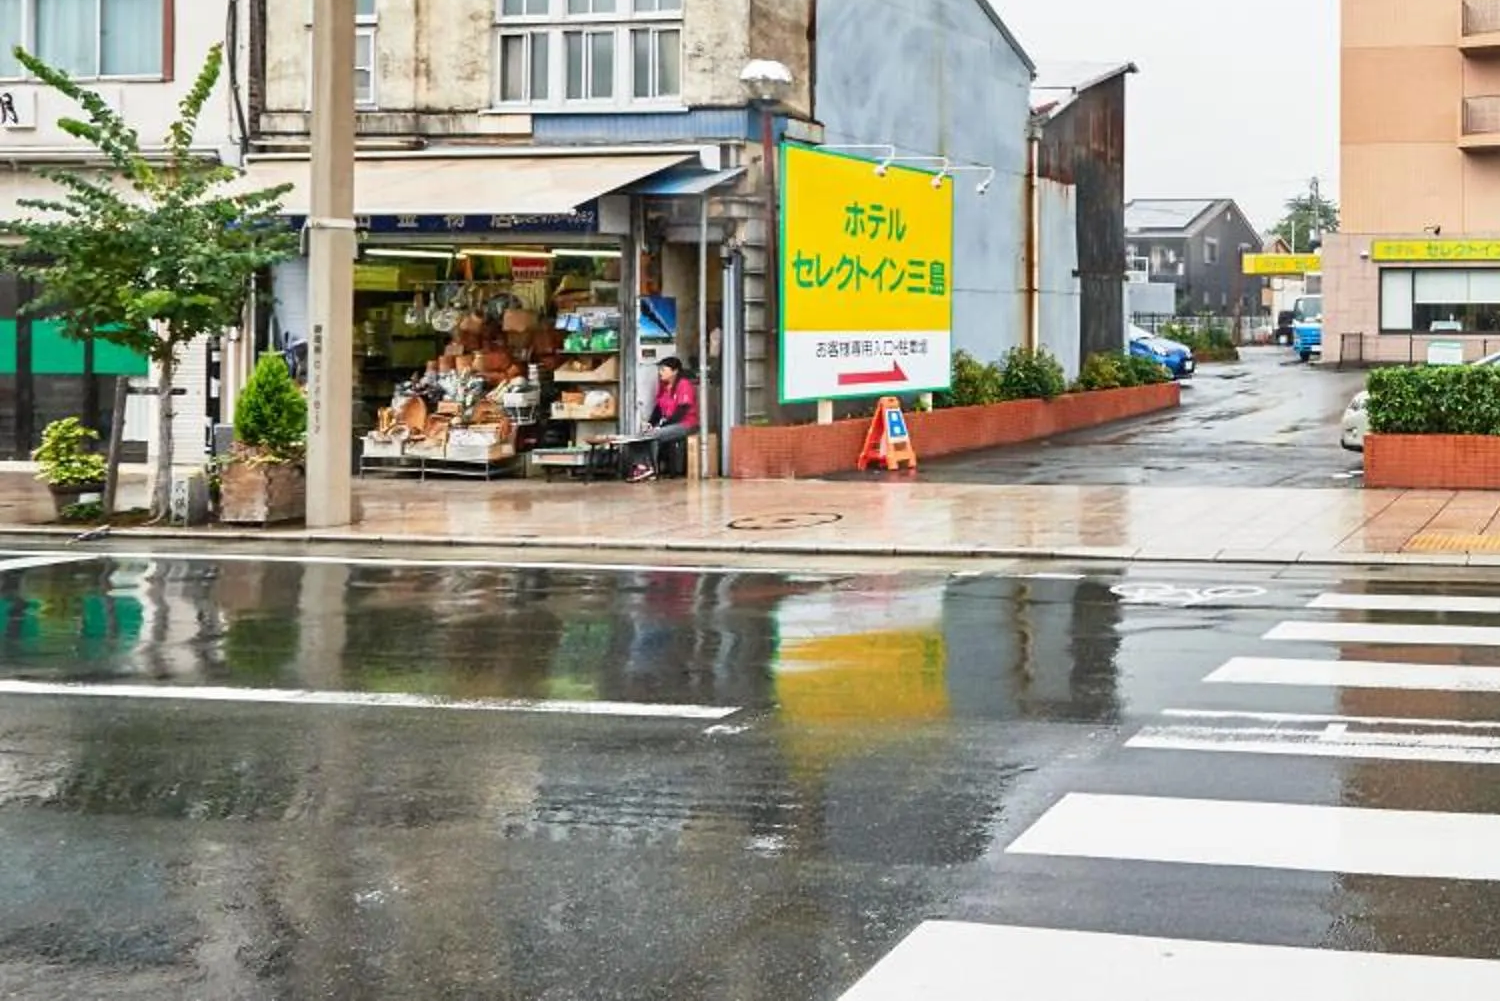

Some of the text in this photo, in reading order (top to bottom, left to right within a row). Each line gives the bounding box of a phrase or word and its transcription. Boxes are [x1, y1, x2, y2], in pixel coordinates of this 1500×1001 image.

[844, 200, 907, 241] ホテル
[792, 250, 945, 296] セレクトイン三島
